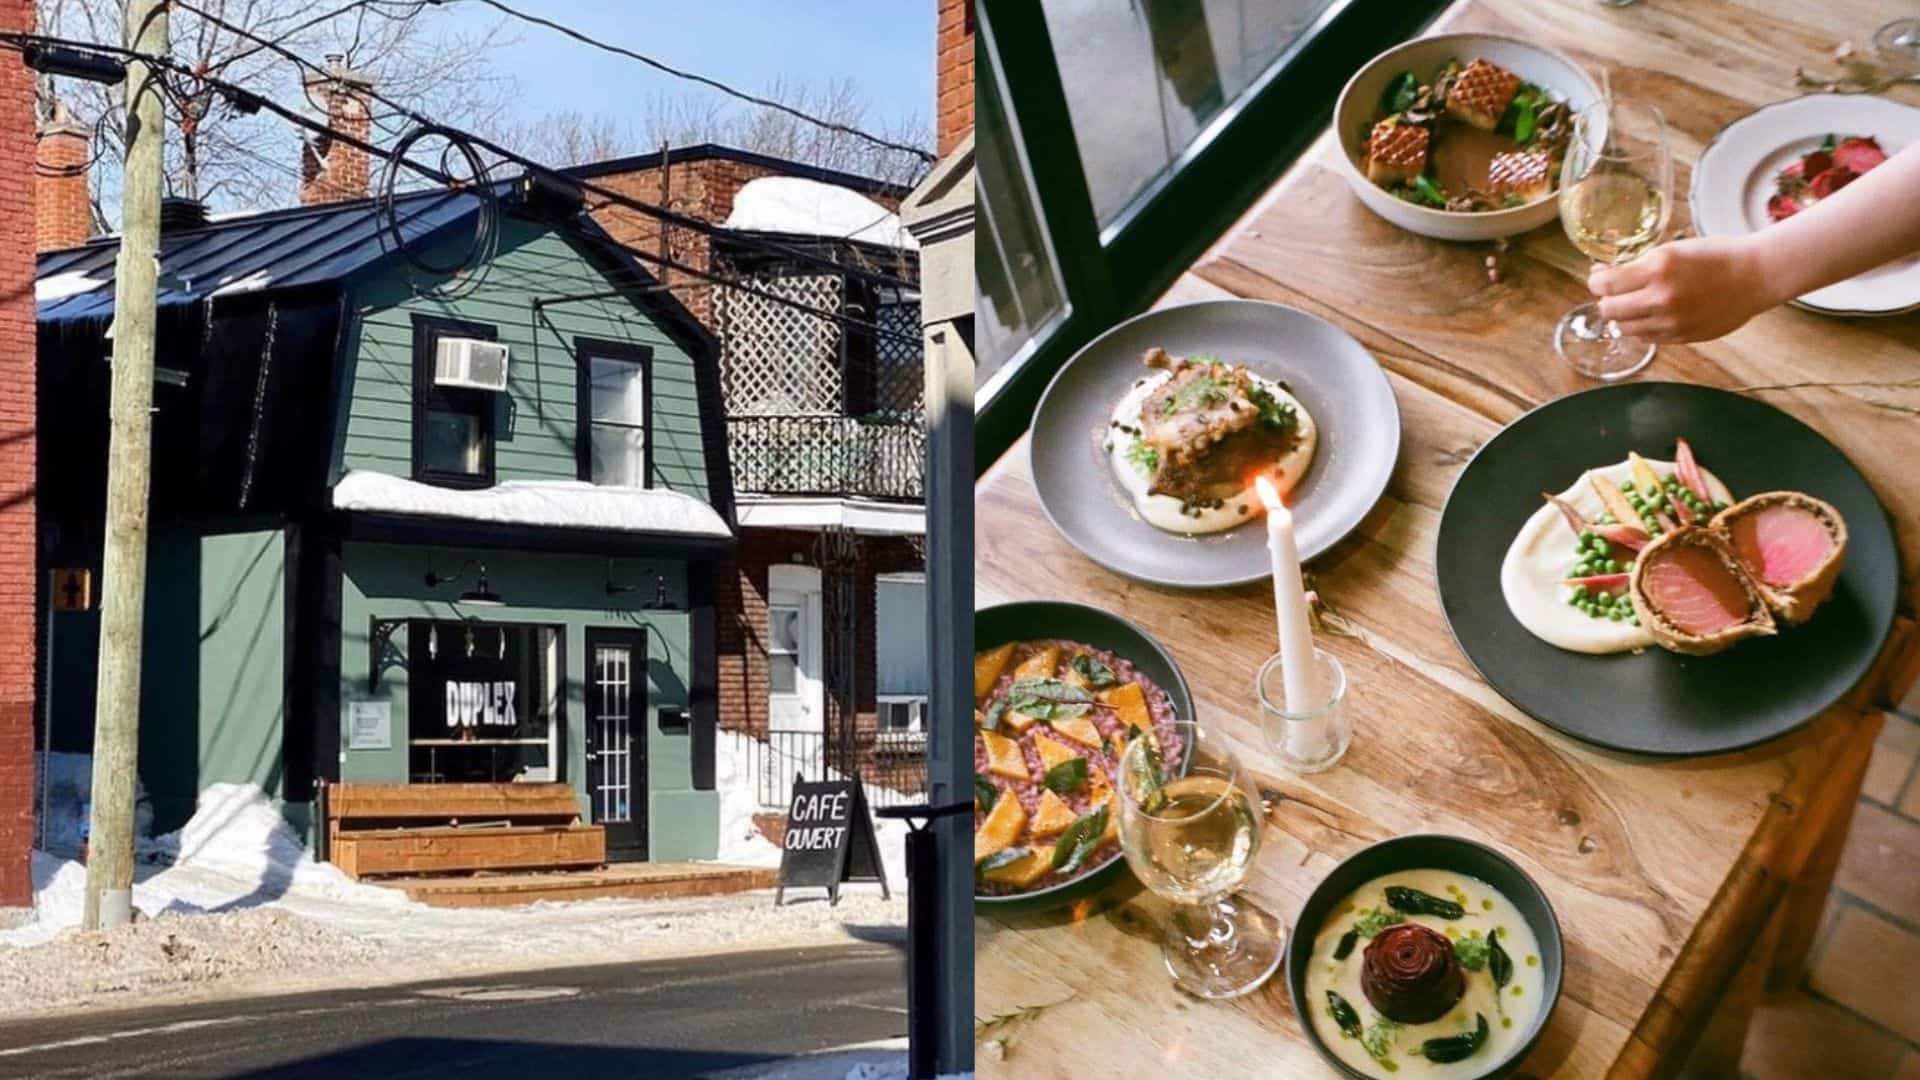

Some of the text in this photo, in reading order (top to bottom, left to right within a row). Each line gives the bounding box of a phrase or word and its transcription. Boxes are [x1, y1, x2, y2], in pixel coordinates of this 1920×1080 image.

[446, 680, 517, 727] DUPLEX
[792, 790, 848, 821] CAFÉ
[785, 827, 846, 850] OUVERT
